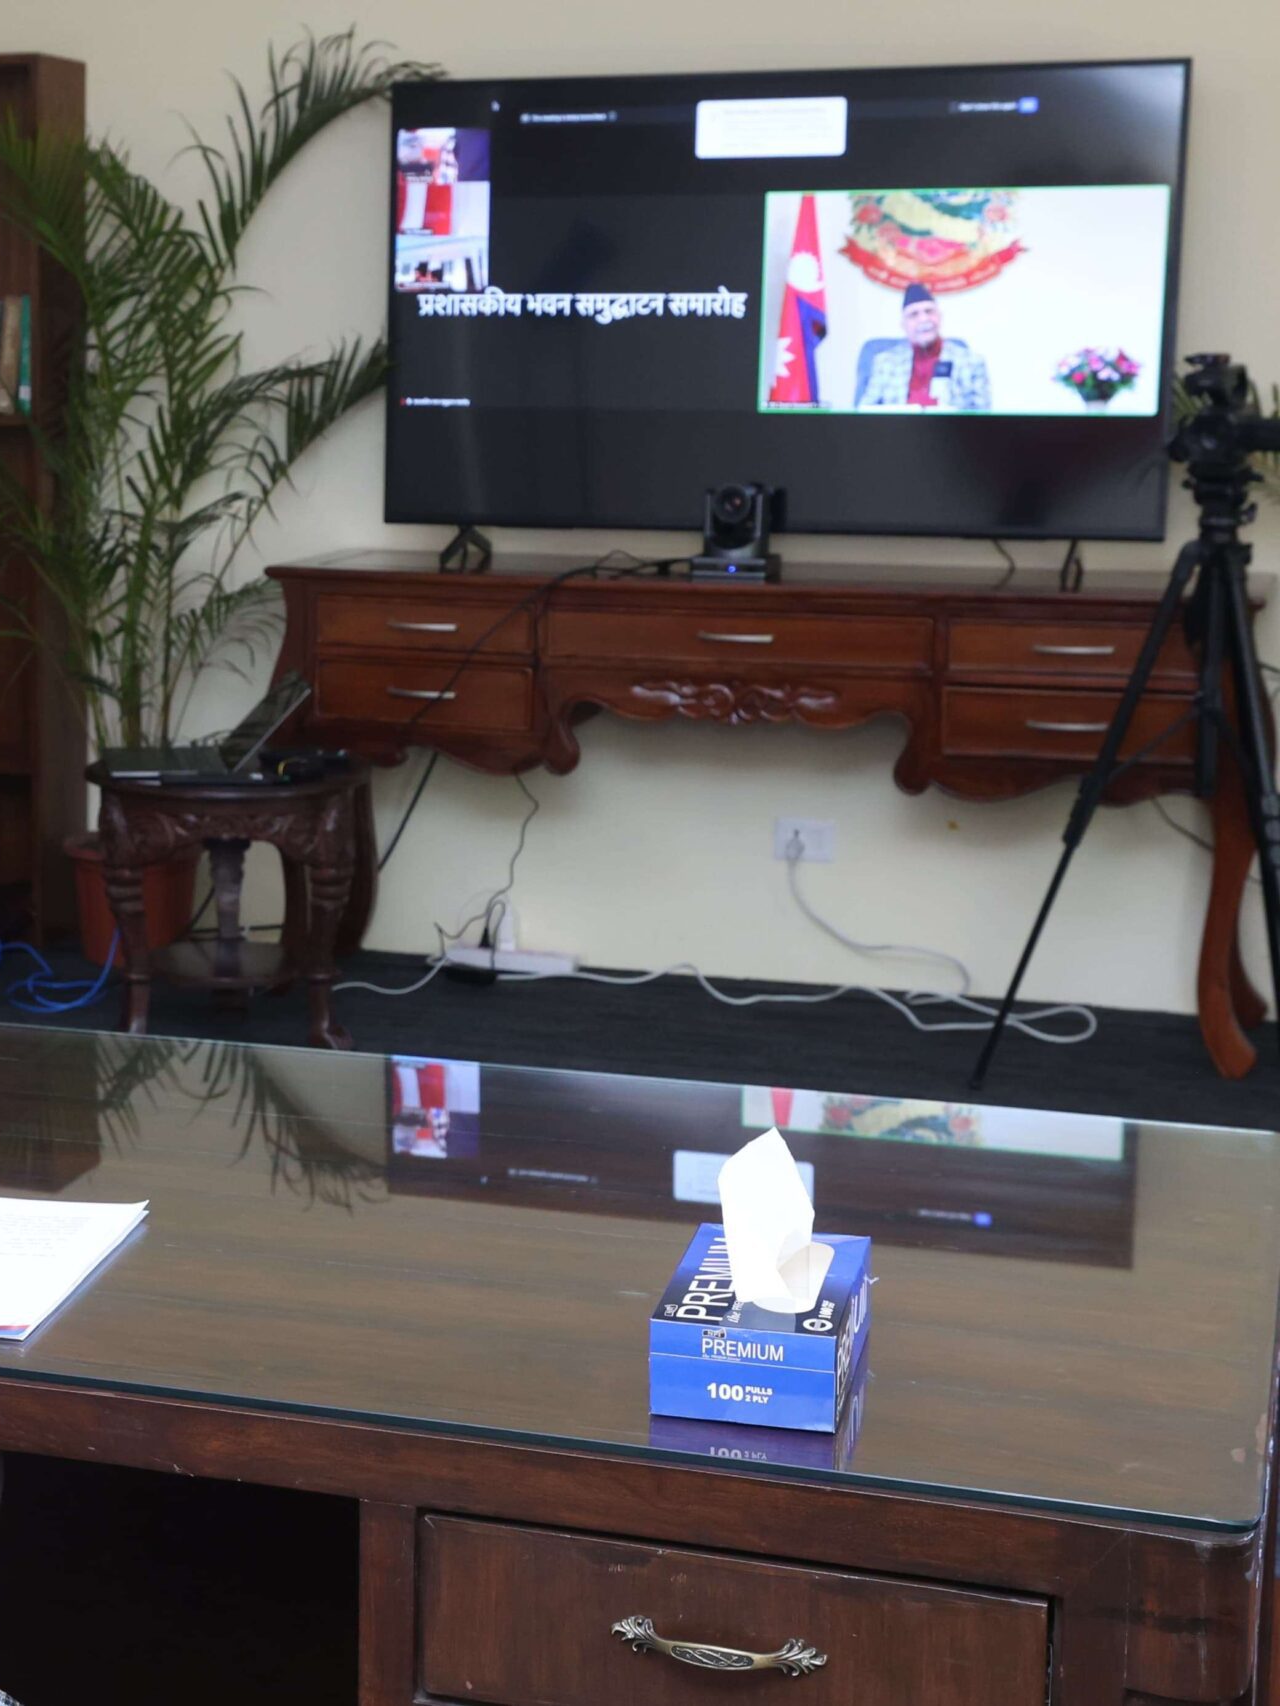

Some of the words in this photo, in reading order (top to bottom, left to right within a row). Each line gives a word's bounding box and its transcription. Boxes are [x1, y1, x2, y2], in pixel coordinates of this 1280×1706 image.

[417, 286, 522, 317] प्रशासकीय
[525, 293, 572, 317] भवन
[668, 285, 748, 319] समारोह
[701, 1338, 784, 1362] PREMIUM
[706, 1382, 744, 1401] 100
[745, 1385, 773, 1396] PULLS
[745, 1394, 751, 1402] 2
[752, 1395, 769, 1404] PLY
